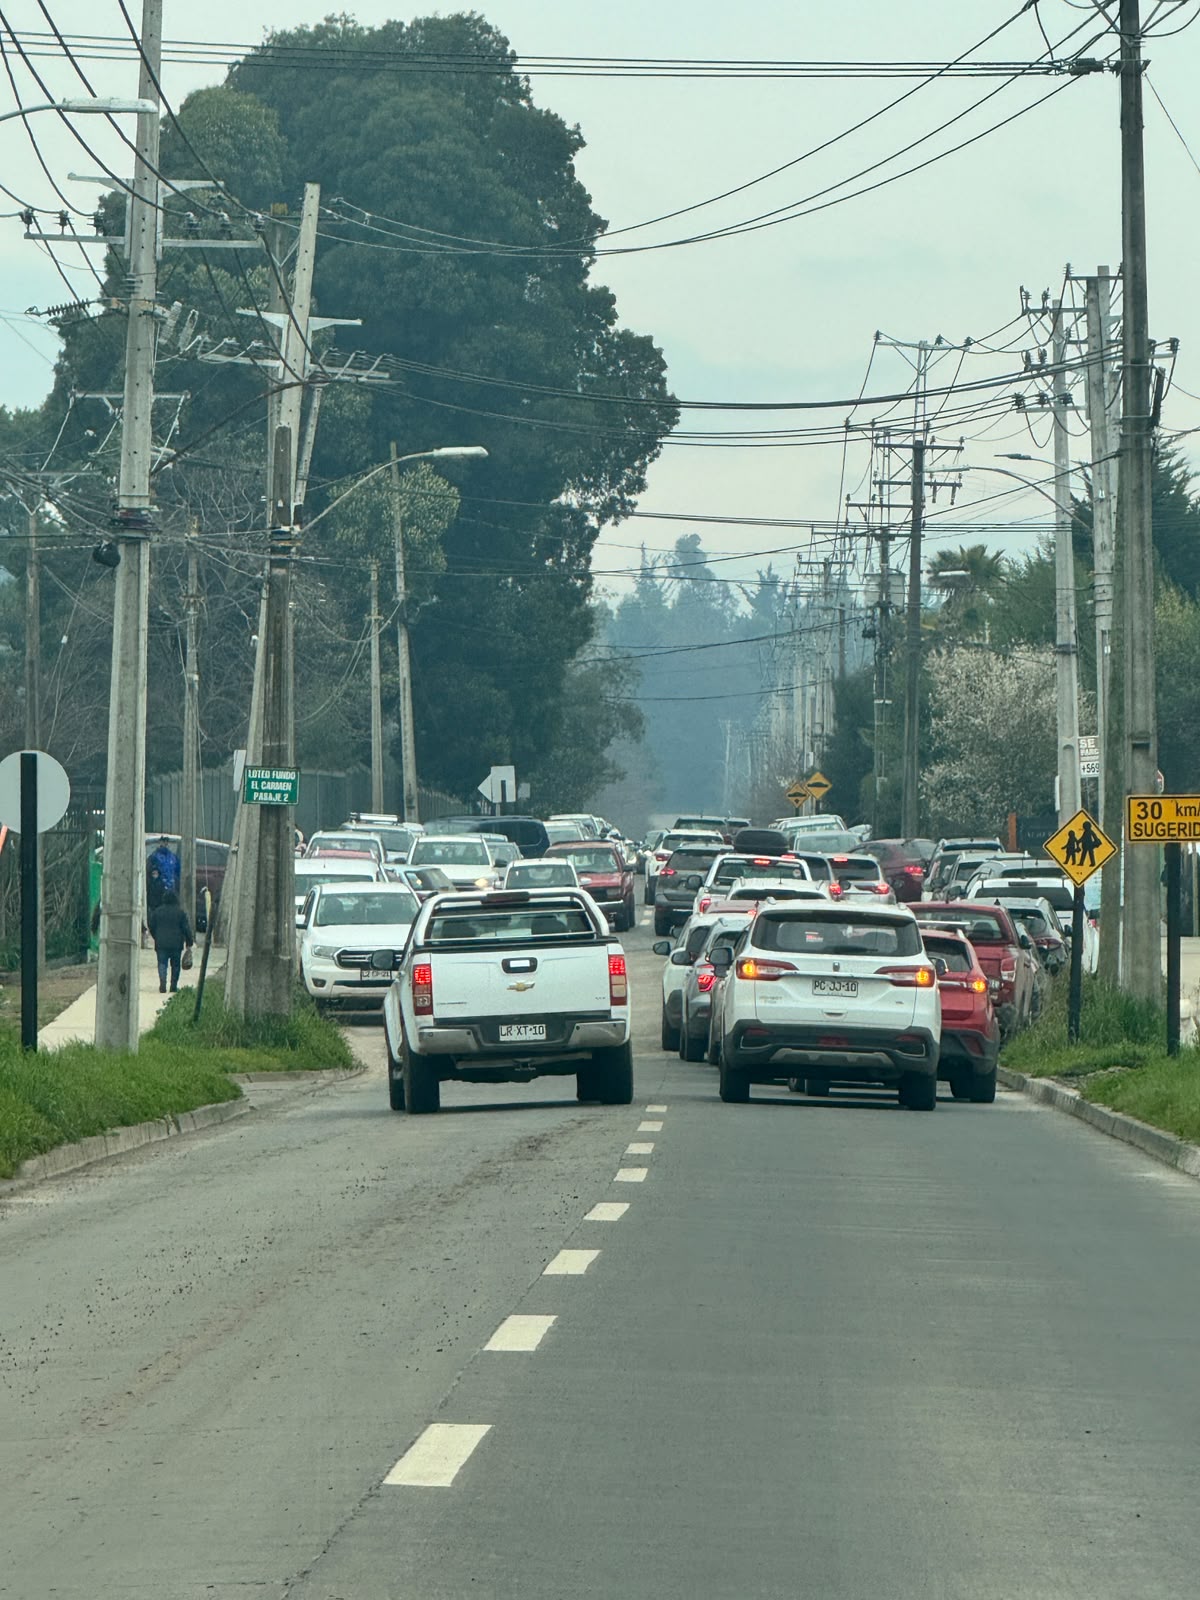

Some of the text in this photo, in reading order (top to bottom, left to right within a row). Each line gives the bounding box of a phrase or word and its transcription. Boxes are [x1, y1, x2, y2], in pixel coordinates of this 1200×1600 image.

[272, 770, 296, 780] FUNDO
[251, 781, 292, 791] EL CARMEN
[283, 793, 289, 802] 2
[1136, 801, 1163, 820] 30
